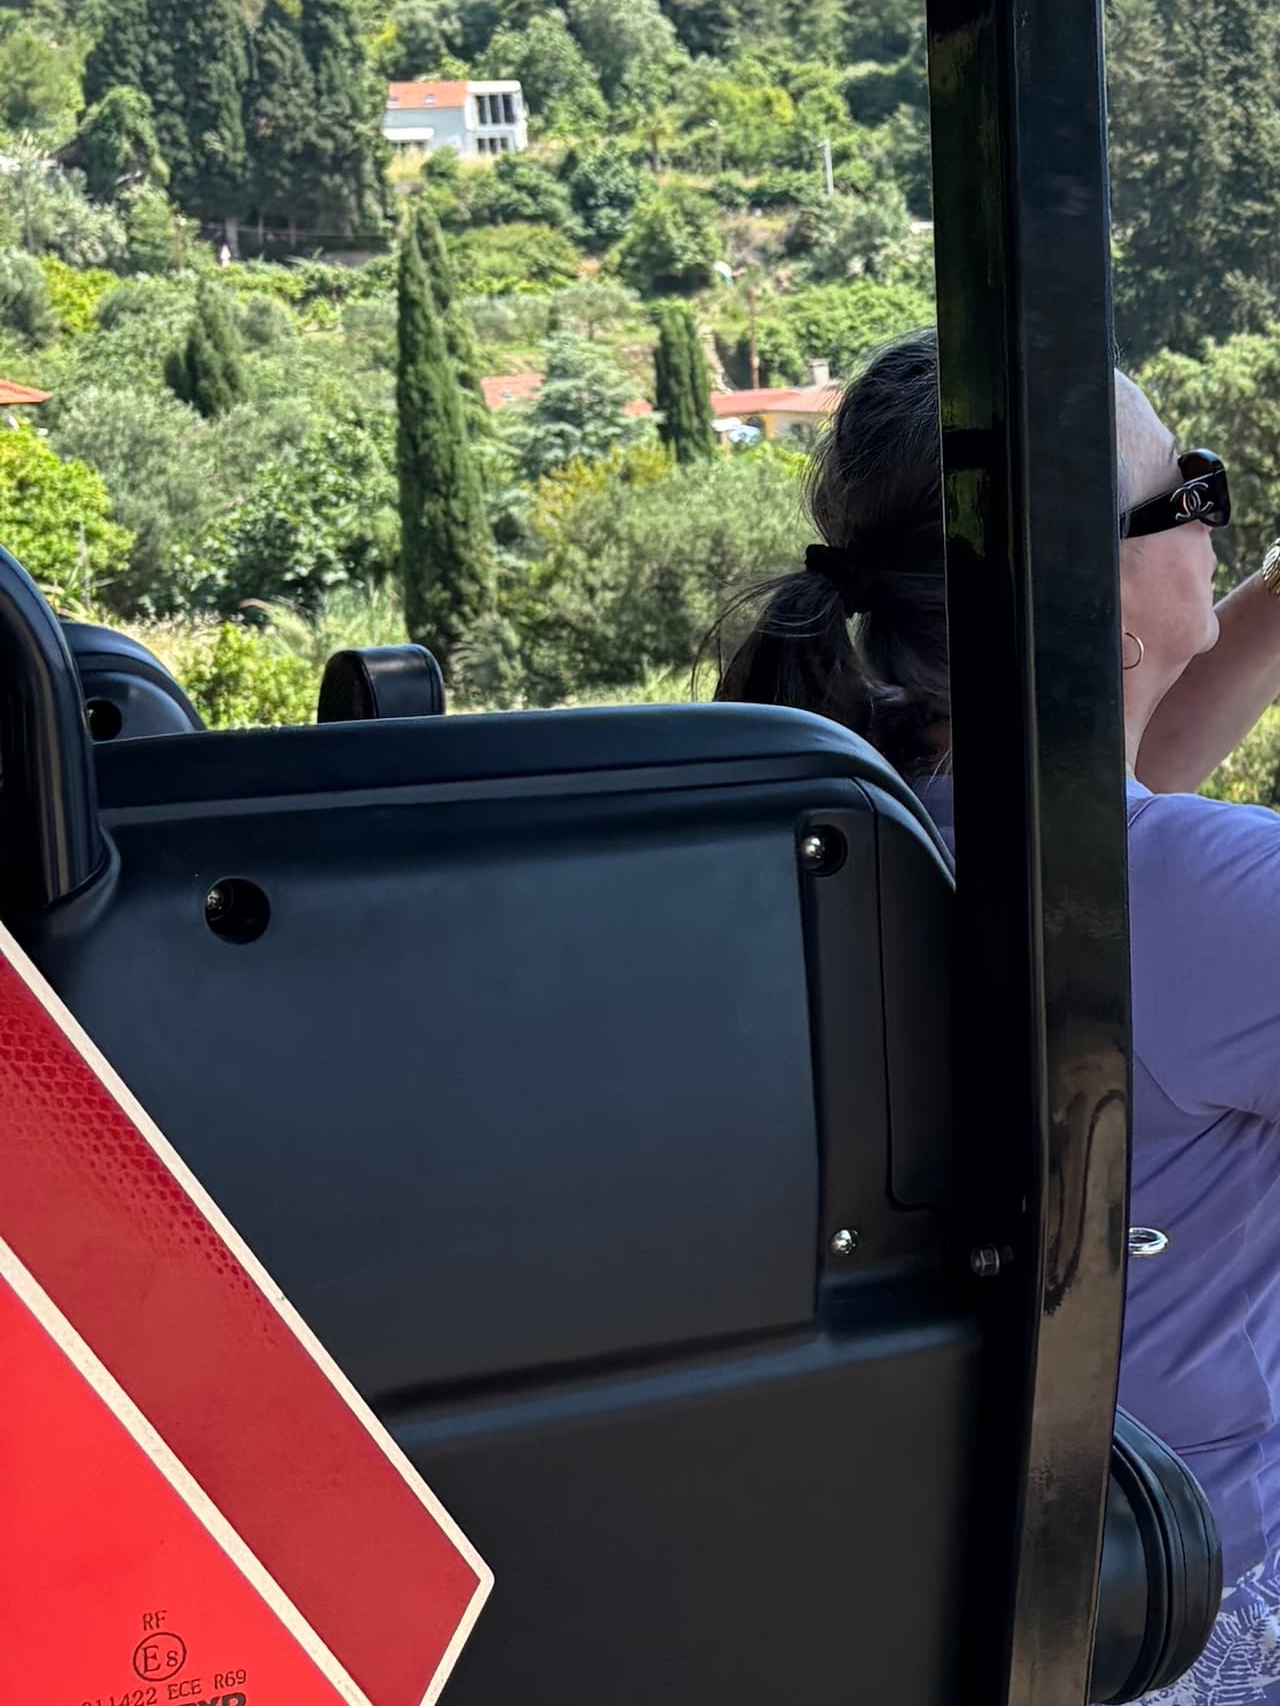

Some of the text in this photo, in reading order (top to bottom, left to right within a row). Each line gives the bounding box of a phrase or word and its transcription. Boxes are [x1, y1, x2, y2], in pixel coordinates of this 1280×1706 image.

[142, 1610, 167, 1631] RF
[167, 1679, 202, 1700] ECE
[214, 1669, 247, 1689] R69
